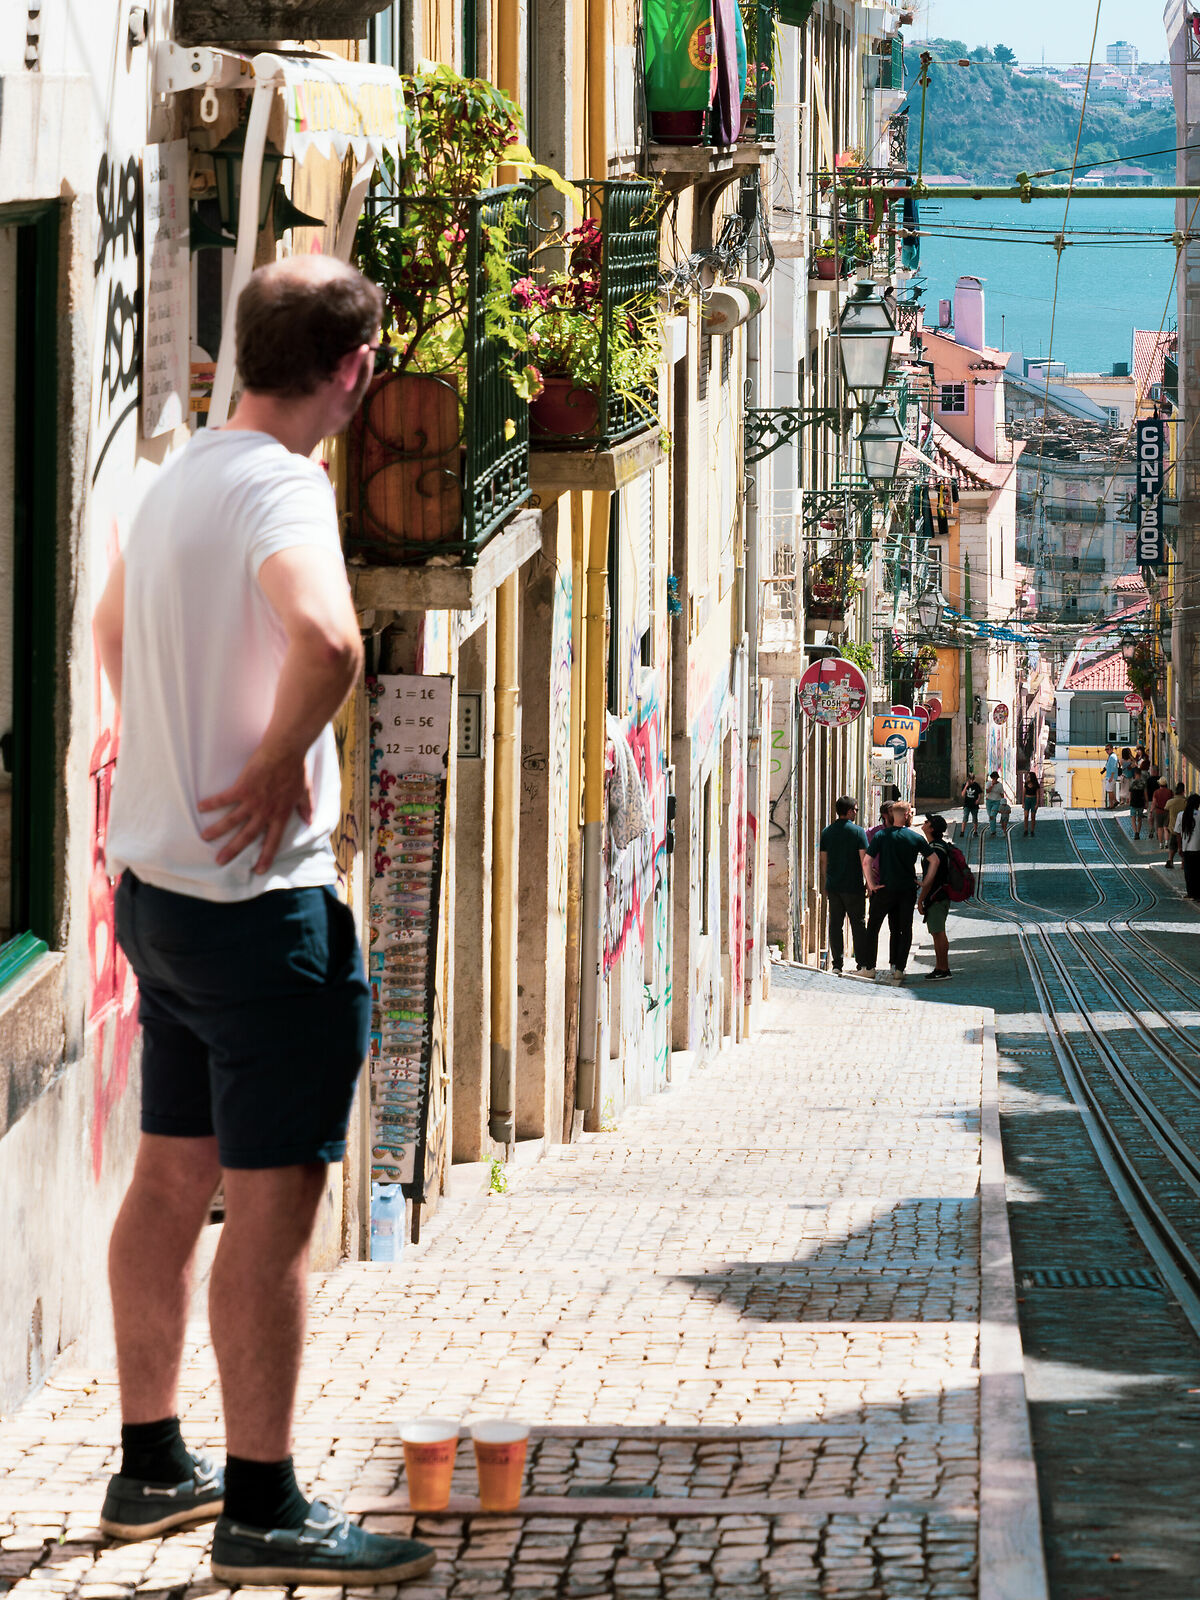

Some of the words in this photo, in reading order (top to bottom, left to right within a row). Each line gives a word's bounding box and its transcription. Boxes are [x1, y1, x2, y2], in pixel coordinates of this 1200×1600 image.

[395, 689, 402, 699] 1
[420, 689, 435, 699] 1€
[394, 716, 401, 727] 6
[419, 717, 434, 727] 5€
[882, 719, 914, 731] ATM
[386, 743, 400, 754] 12
[418, 744, 441, 755] 10€
